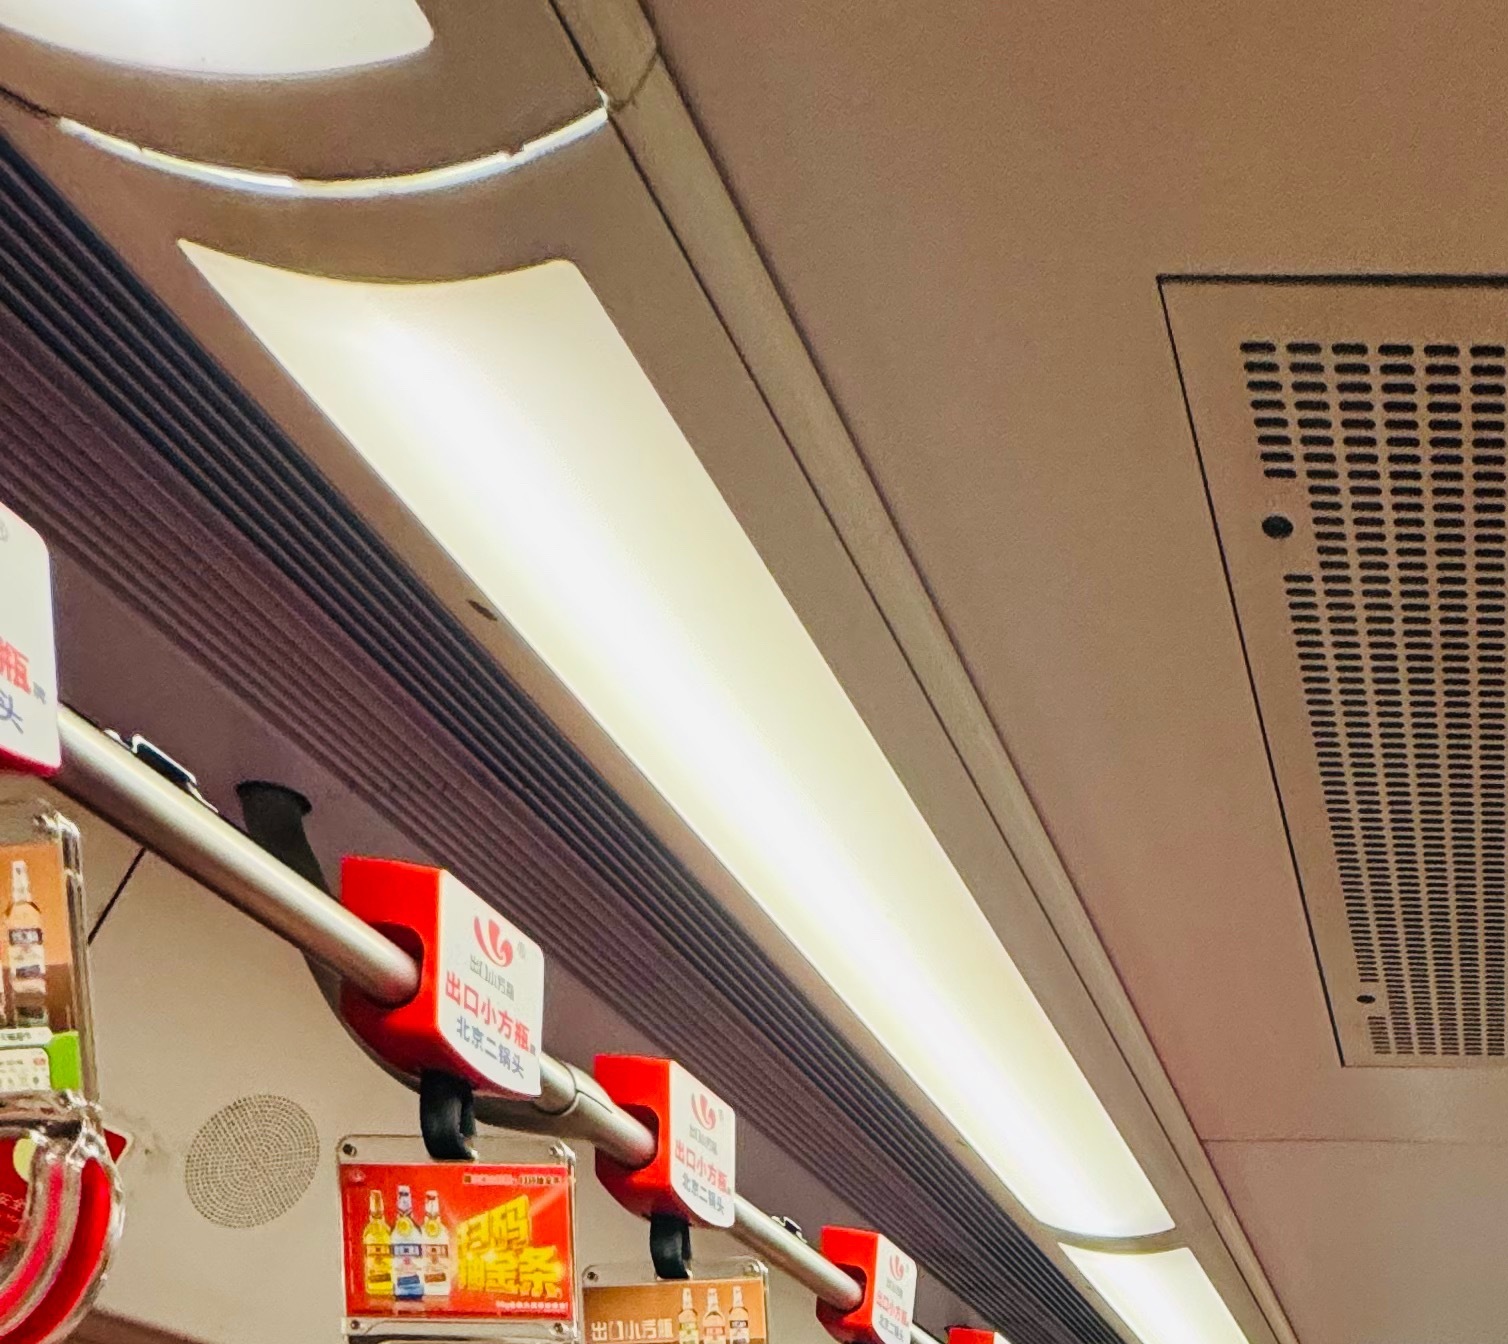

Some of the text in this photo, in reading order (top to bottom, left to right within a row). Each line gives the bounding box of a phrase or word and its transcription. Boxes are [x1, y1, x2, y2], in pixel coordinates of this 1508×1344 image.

[456, 1015, 525, 1080] 北京二锅头
[457, 1194, 530, 1250] 扫码
